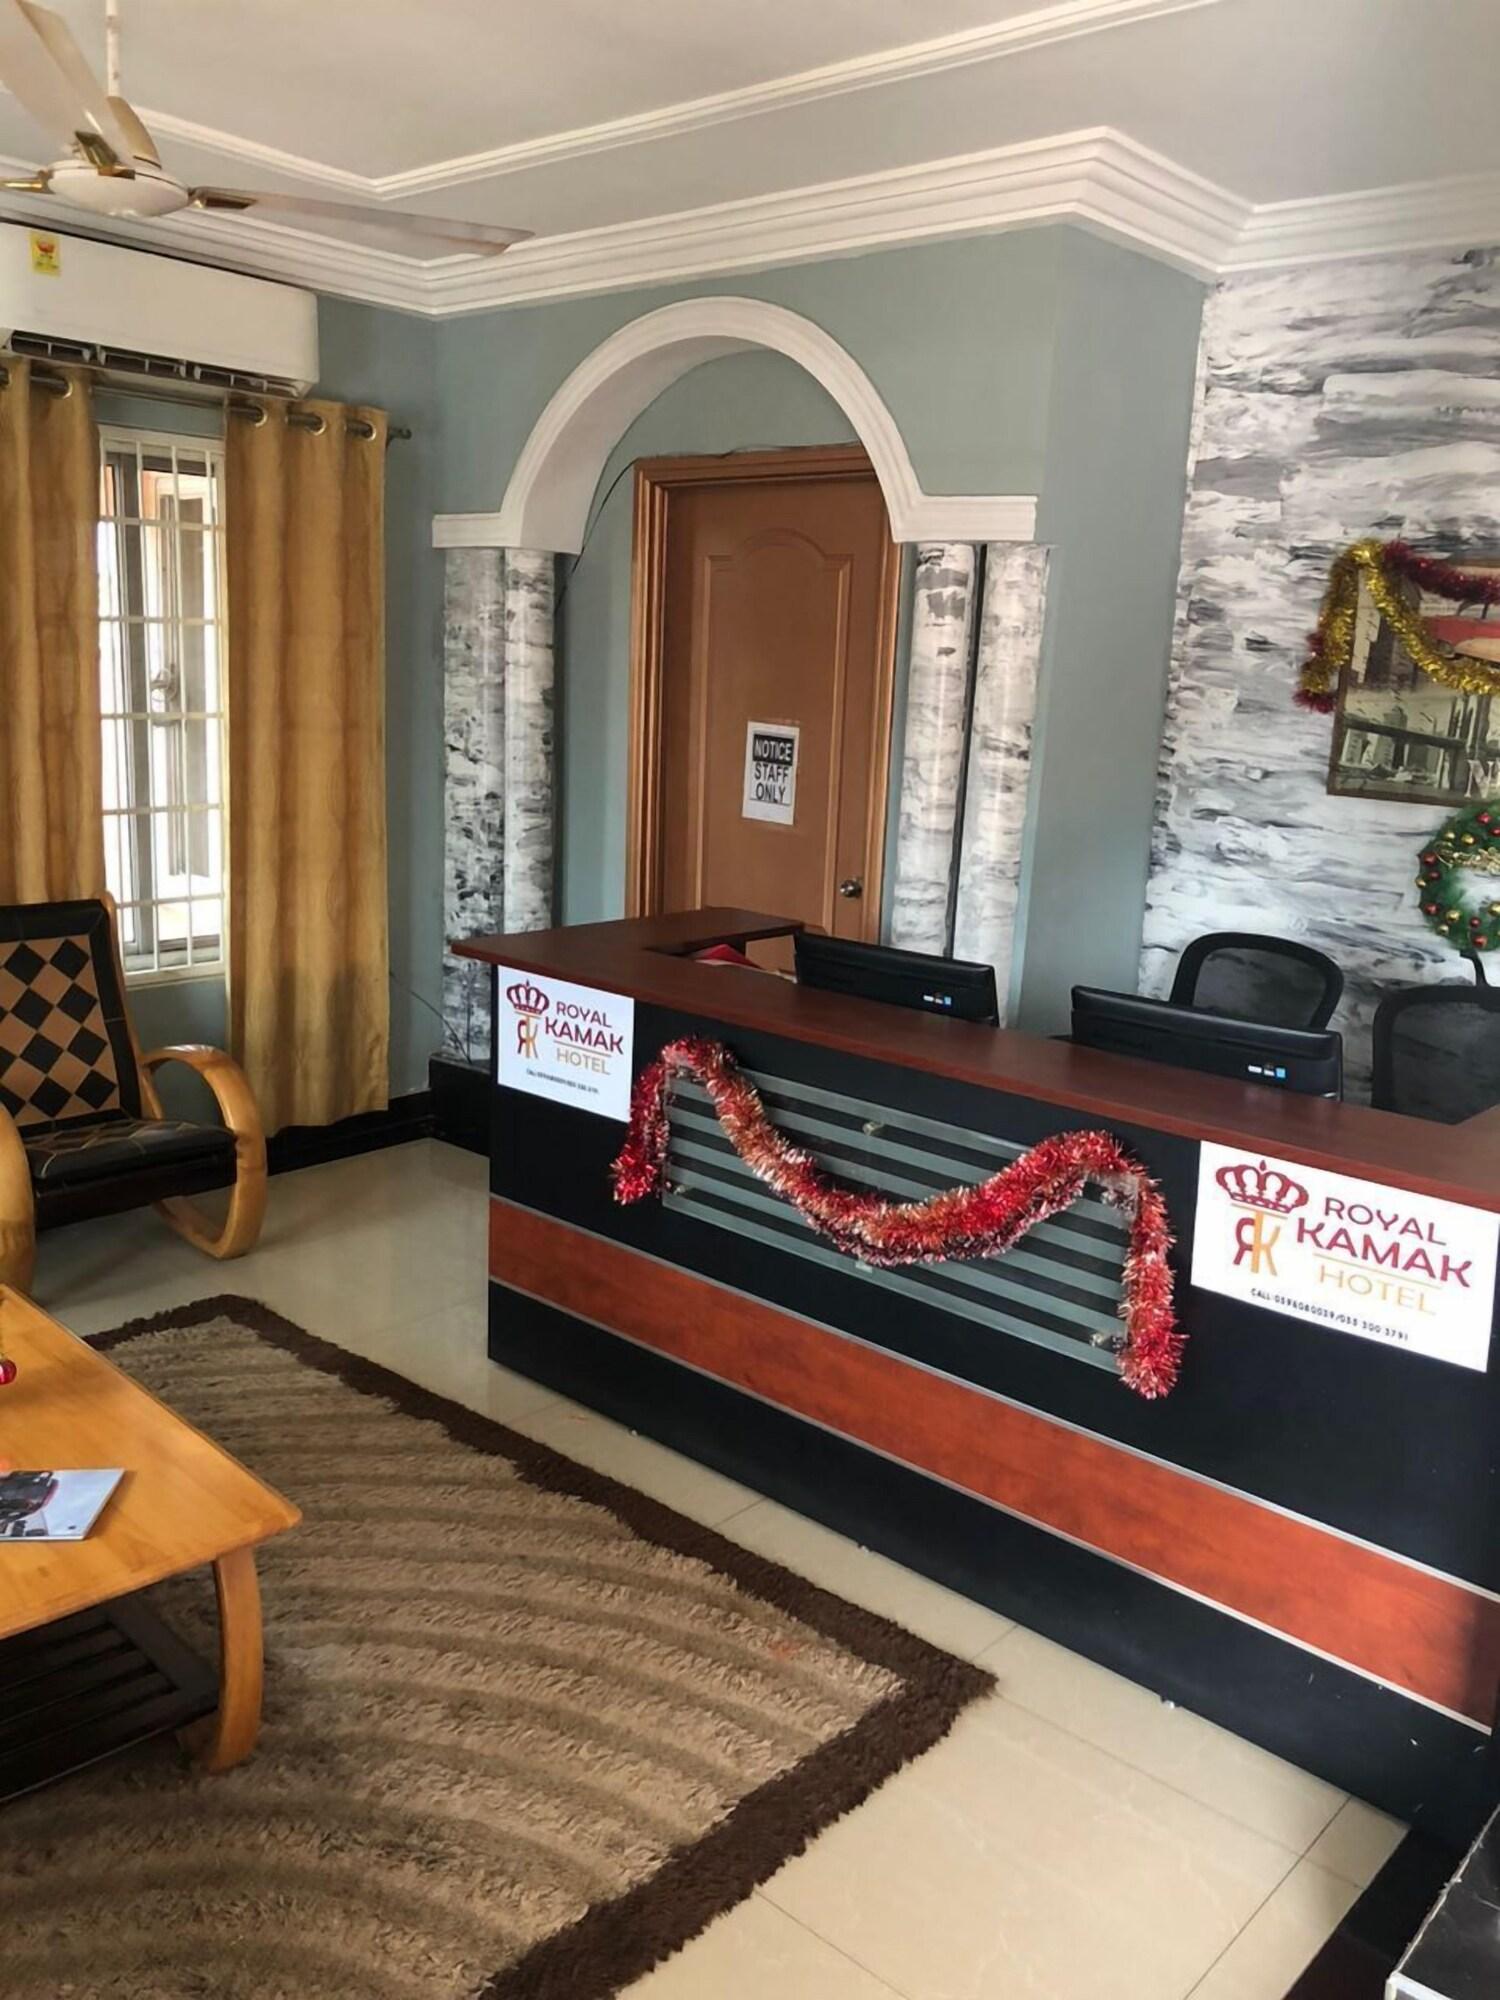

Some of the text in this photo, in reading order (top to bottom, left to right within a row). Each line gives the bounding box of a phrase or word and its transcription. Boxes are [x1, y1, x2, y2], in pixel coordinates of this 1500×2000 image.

[754, 739, 792, 761] NOTICE
[754, 762, 789, 783] STAFF
[755, 782, 786, 804] ONLY
[556, 1001, 612, 1028] ROYAL
[545, 1016, 624, 1055] KAMAK
[556, 1048, 610, 1075] HOTEL
[1324, 1197, 1447, 1246] ROYAL
[1297, 1217, 1473, 1288] KAMAK
[1318, 1264, 1437, 1316] HOTEL
